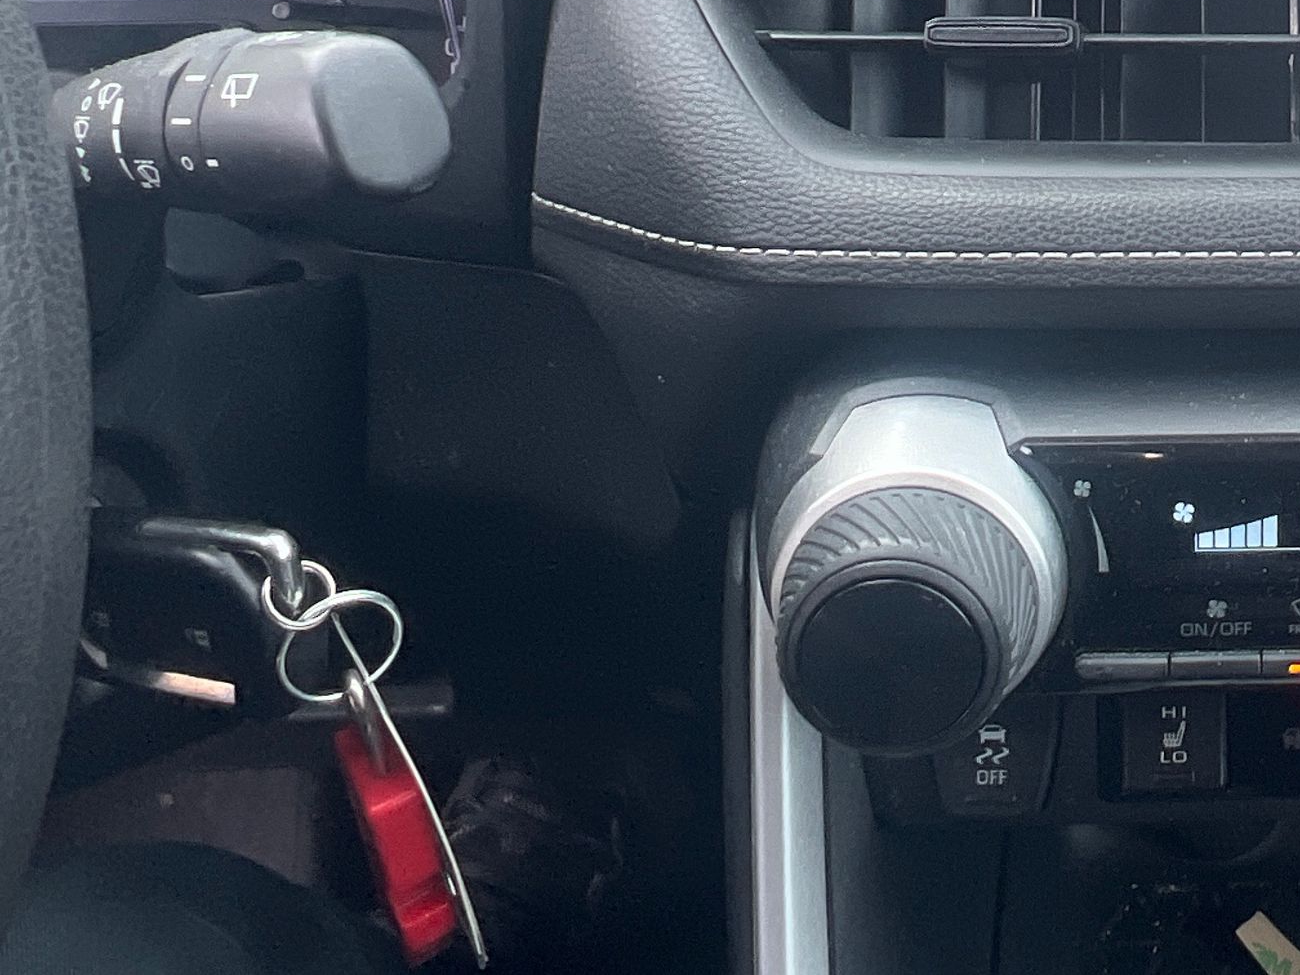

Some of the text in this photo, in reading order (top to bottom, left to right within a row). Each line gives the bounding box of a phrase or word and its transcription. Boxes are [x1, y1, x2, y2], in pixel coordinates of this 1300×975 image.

[1180, 622, 1252, 637] ON/OFF
[1161, 706, 1187, 719] HI
[1160, 750, 1188, 764] LO
[976, 769, 1008, 785] OFF
